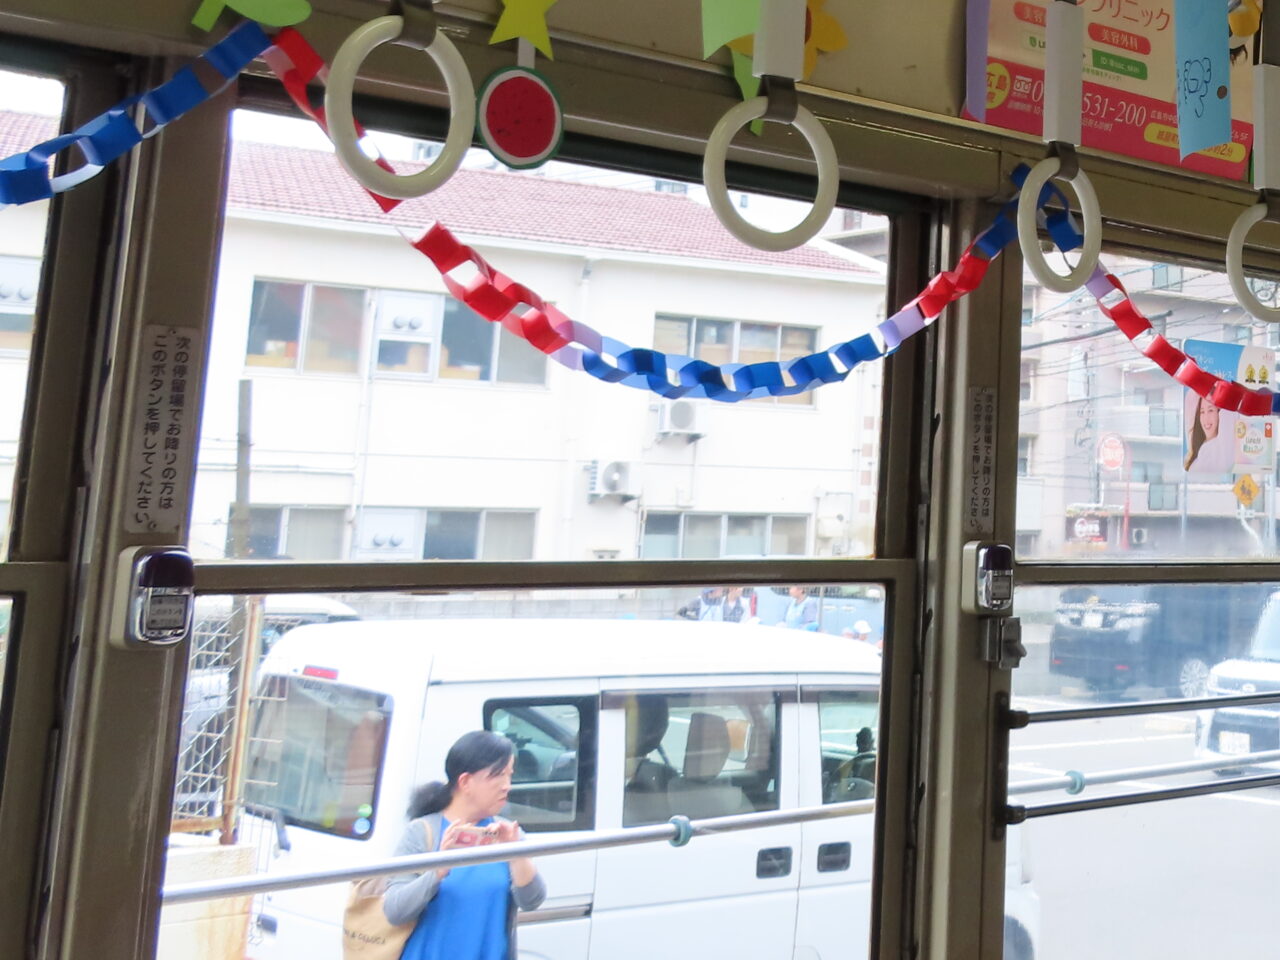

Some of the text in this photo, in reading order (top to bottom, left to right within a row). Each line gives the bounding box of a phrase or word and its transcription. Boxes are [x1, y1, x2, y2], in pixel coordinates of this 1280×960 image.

[134, 333, 168, 525] このボタンを押してください
[158, 336, 192, 511] 次の停留場でお降りの方は
